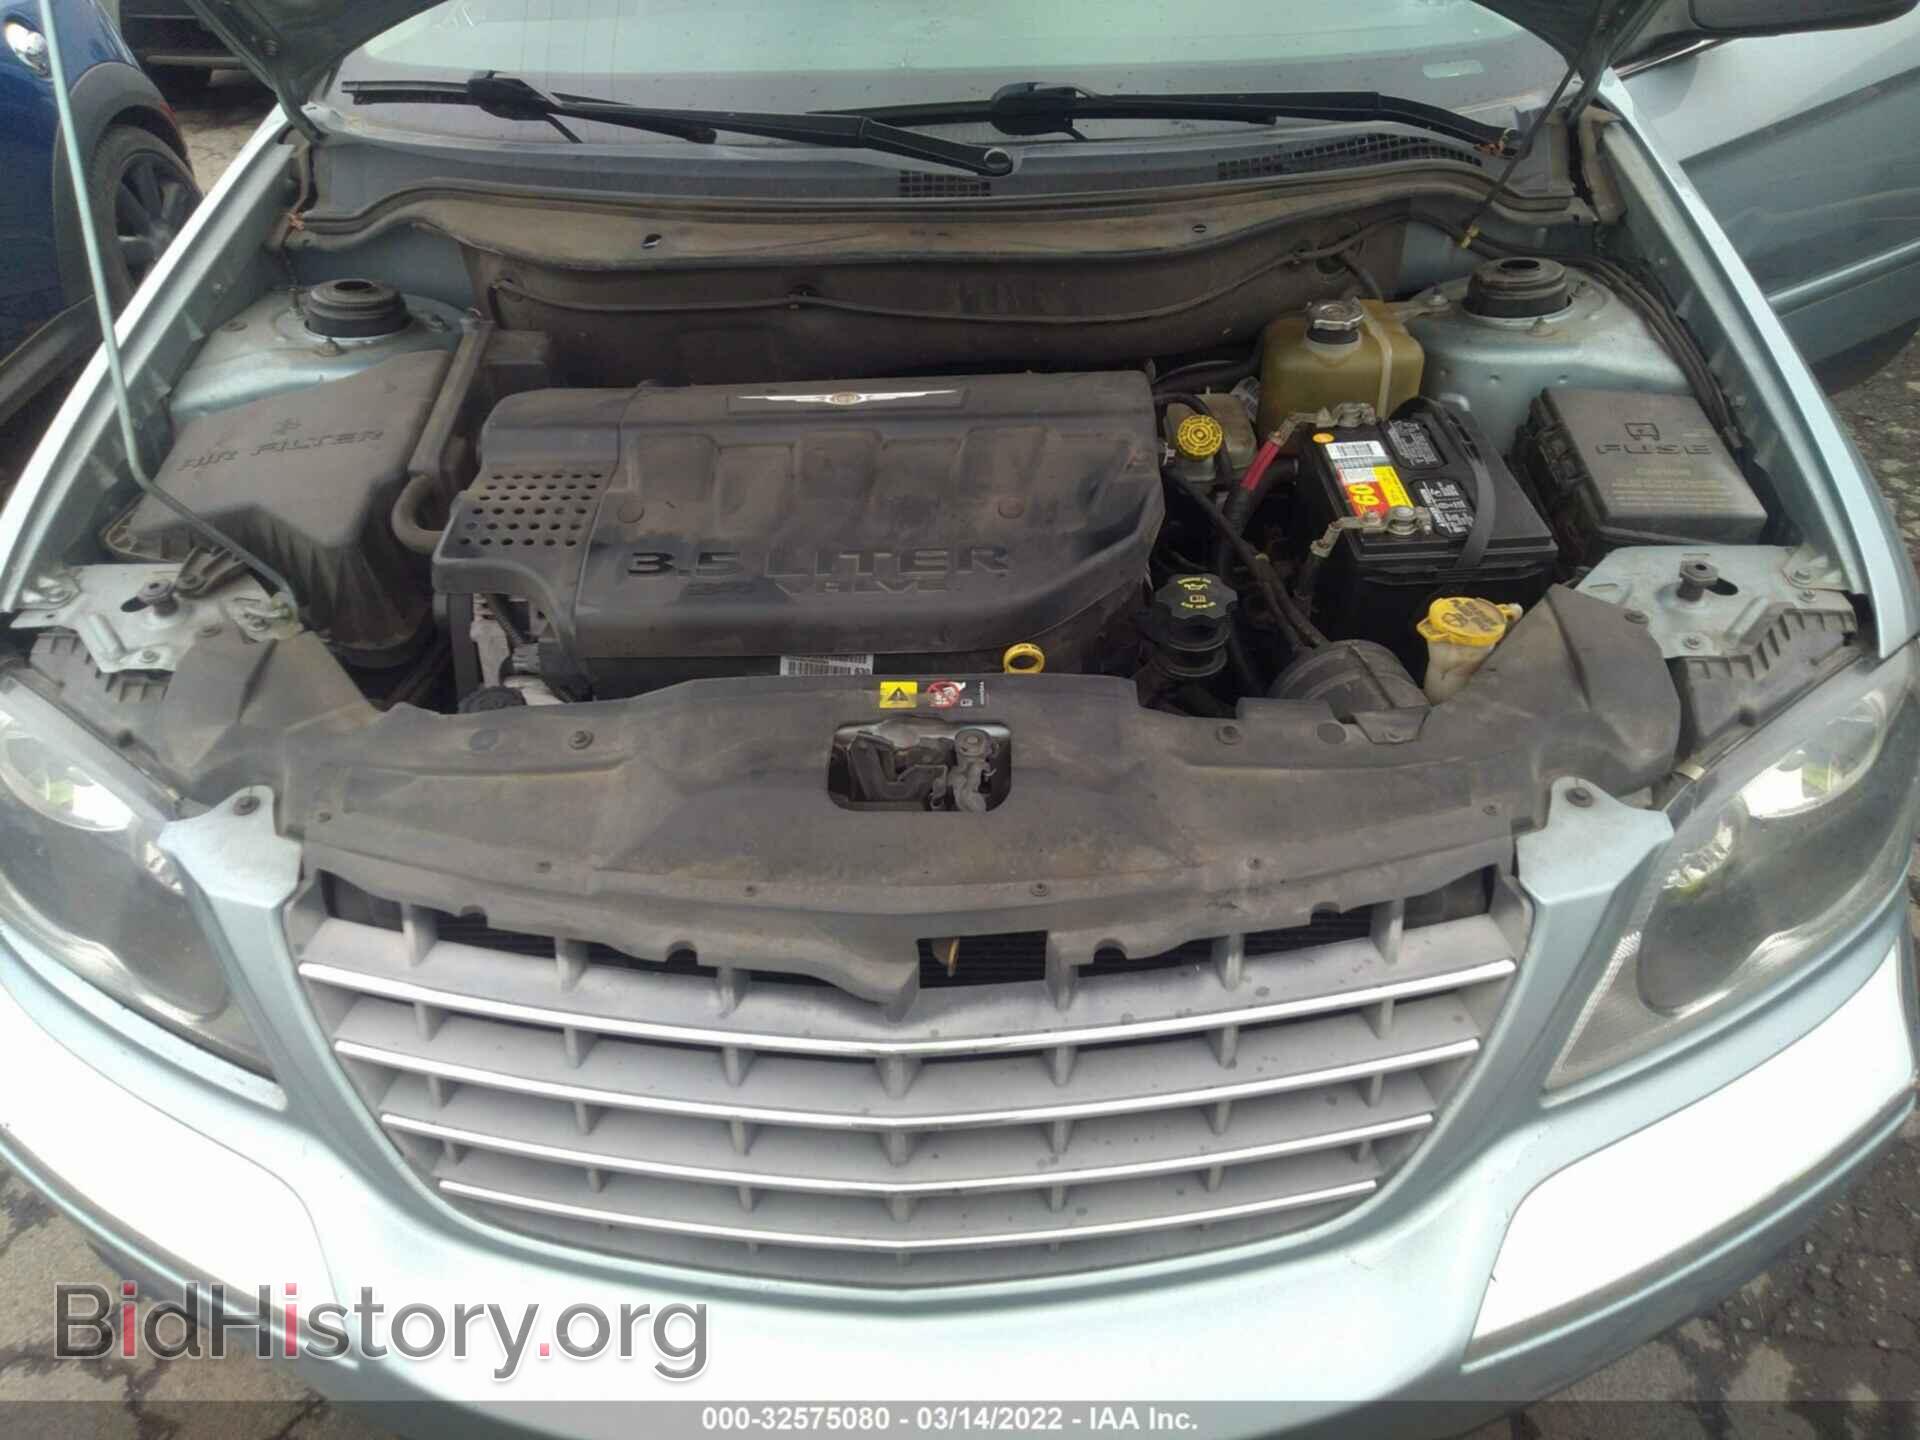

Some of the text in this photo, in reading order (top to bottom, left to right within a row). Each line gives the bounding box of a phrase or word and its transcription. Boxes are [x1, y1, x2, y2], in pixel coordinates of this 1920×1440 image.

[176, 429, 384, 472] AIR FILTER
[1595, 443, 1712, 456] FUSE
[1348, 483, 1380, 506] 60
[627, 548, 1008, 577] 3.5 LITER
